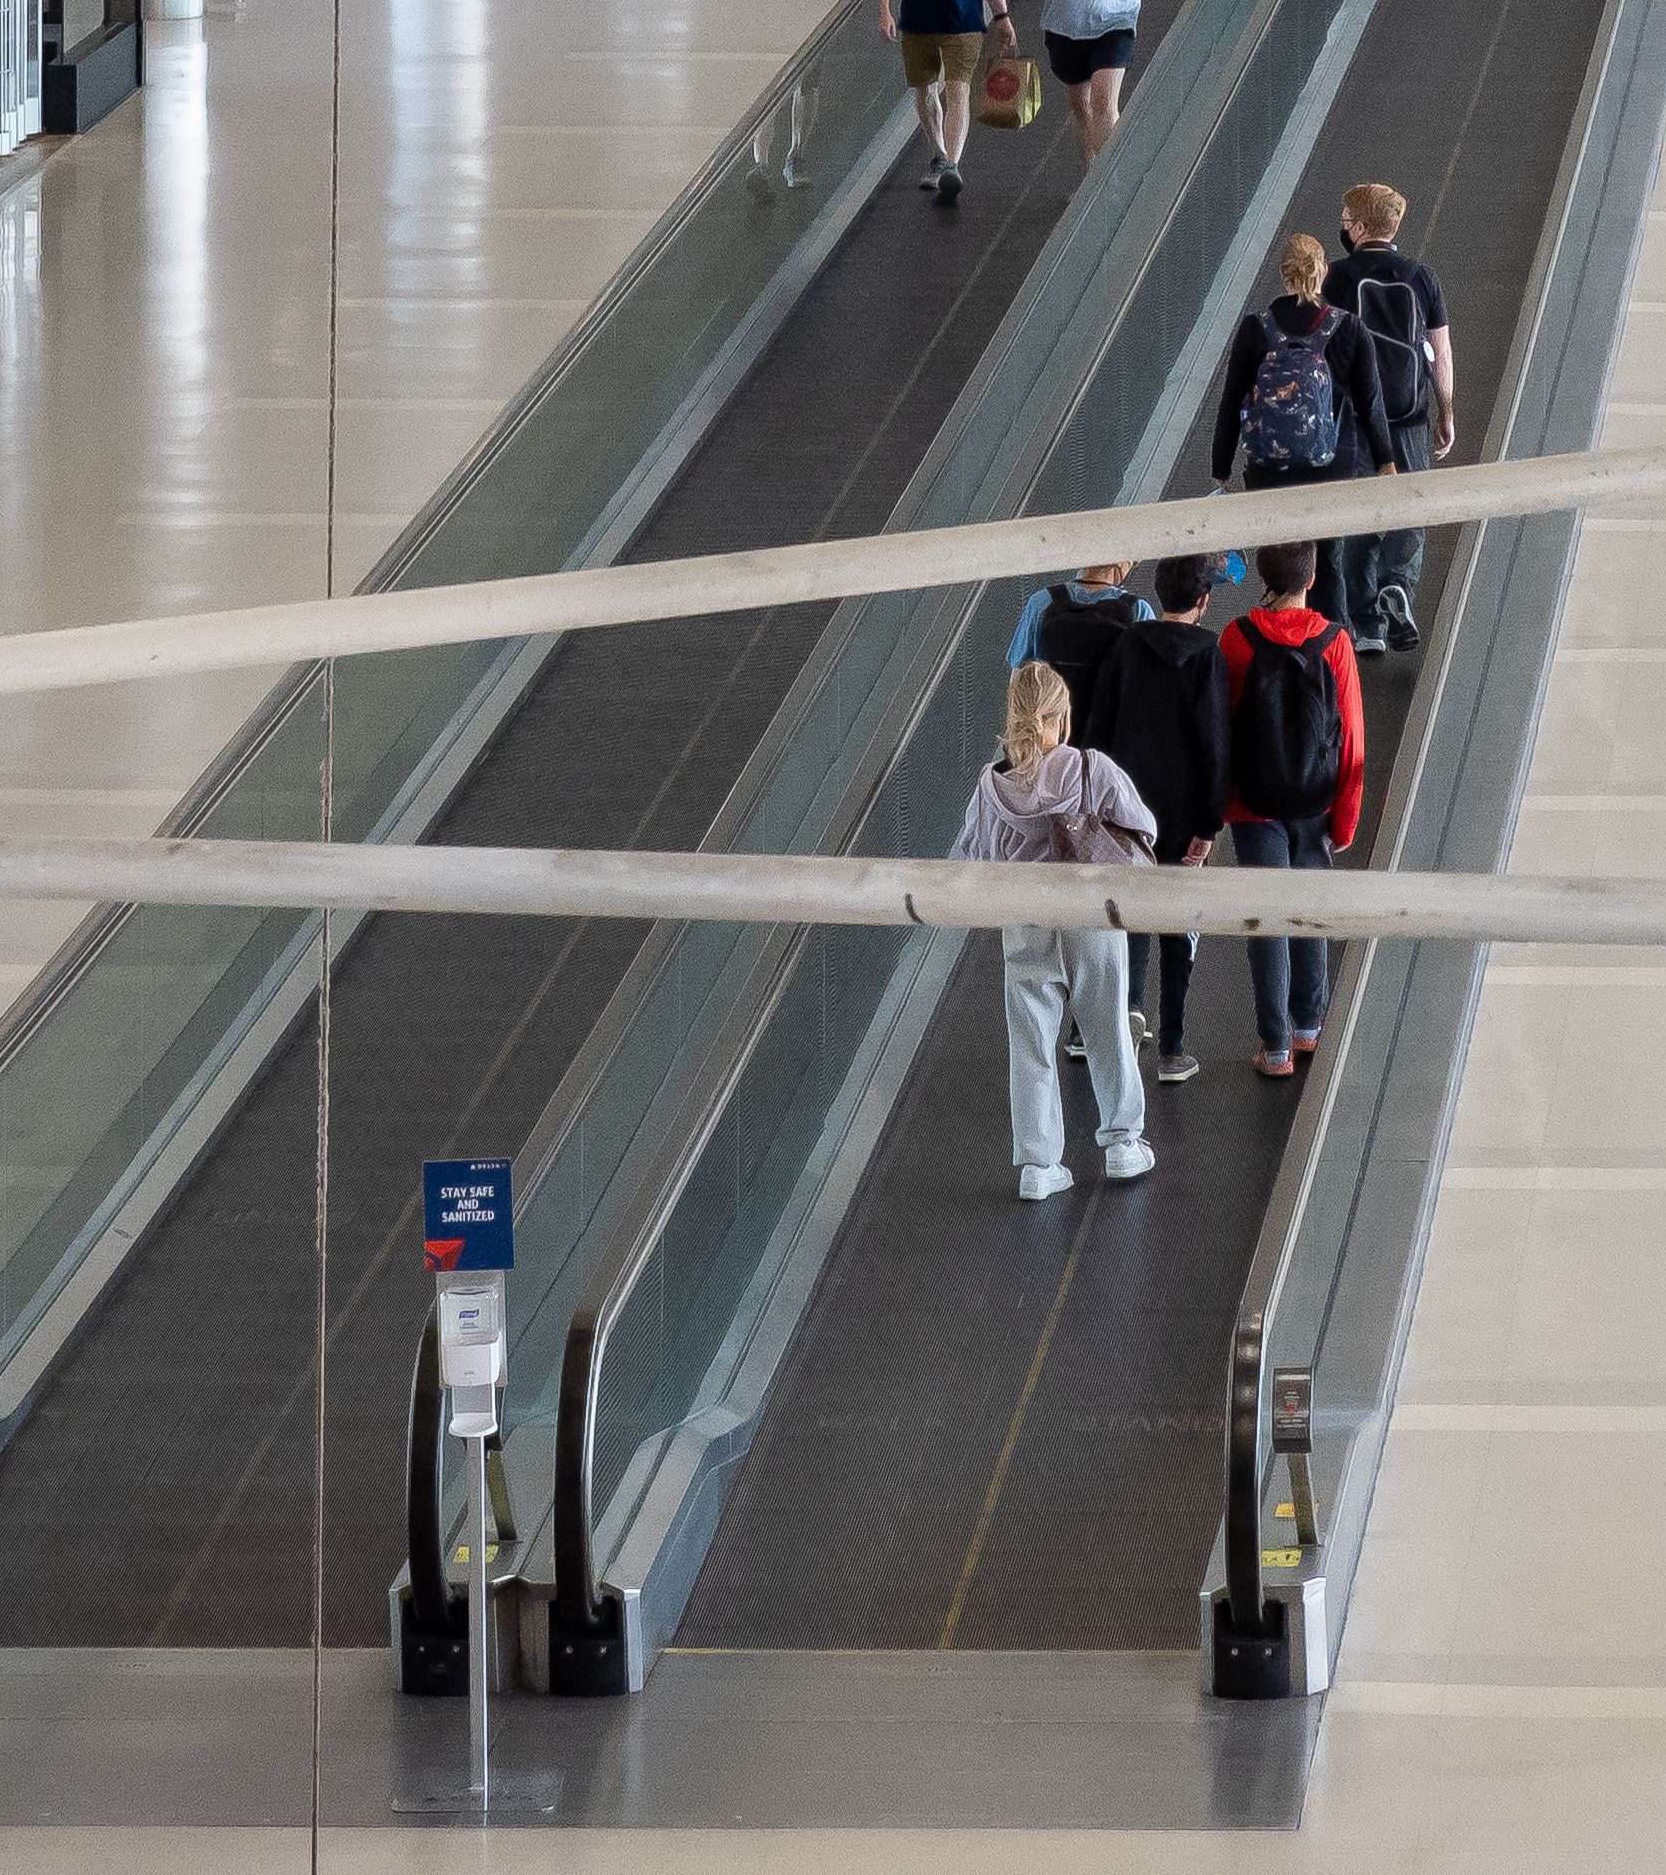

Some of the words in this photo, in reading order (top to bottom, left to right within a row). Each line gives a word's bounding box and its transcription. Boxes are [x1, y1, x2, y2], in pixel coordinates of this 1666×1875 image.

[440, 1186, 467, 1199] STAY
[469, 1186, 494, 1197] SAFE
[457, 1199, 479, 1210] AND
[441, 1210, 495, 1223] SANITIZED
